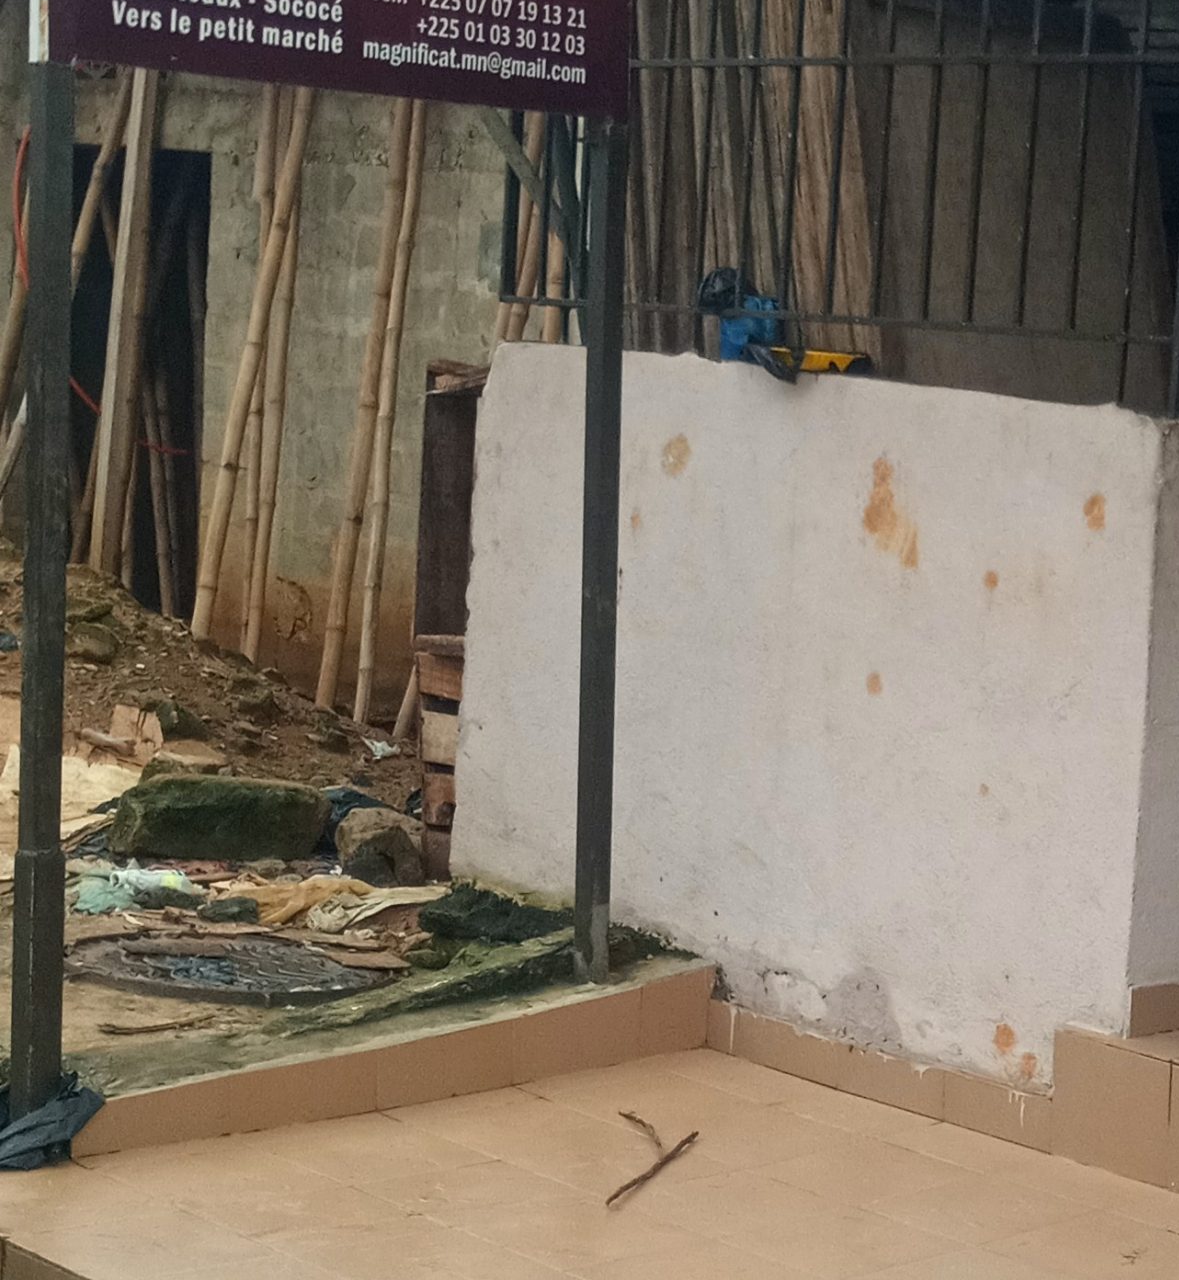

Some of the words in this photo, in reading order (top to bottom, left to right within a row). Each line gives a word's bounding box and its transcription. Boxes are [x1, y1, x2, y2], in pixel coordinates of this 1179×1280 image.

[111, 0, 162, 31] Vers
[169, 7, 192, 35] le
[199, 16, 256, 43] petit
[262, 27, 344, 55] marché
[517, 0, 538, 23] 19
[542, 4, 562, 26] 13
[567, 7, 587, 29] 21
[416, 16, 460, 40] +225
[464, 20, 486, 43] 01
[489, 24, 511, 47] 03
[515, 28, 537, 50] 30
[541, 31, 561, 53] 12
[564, 35, 586, 56] 03
[362, 41, 587, 85] magnificat.mn@gmail.com
